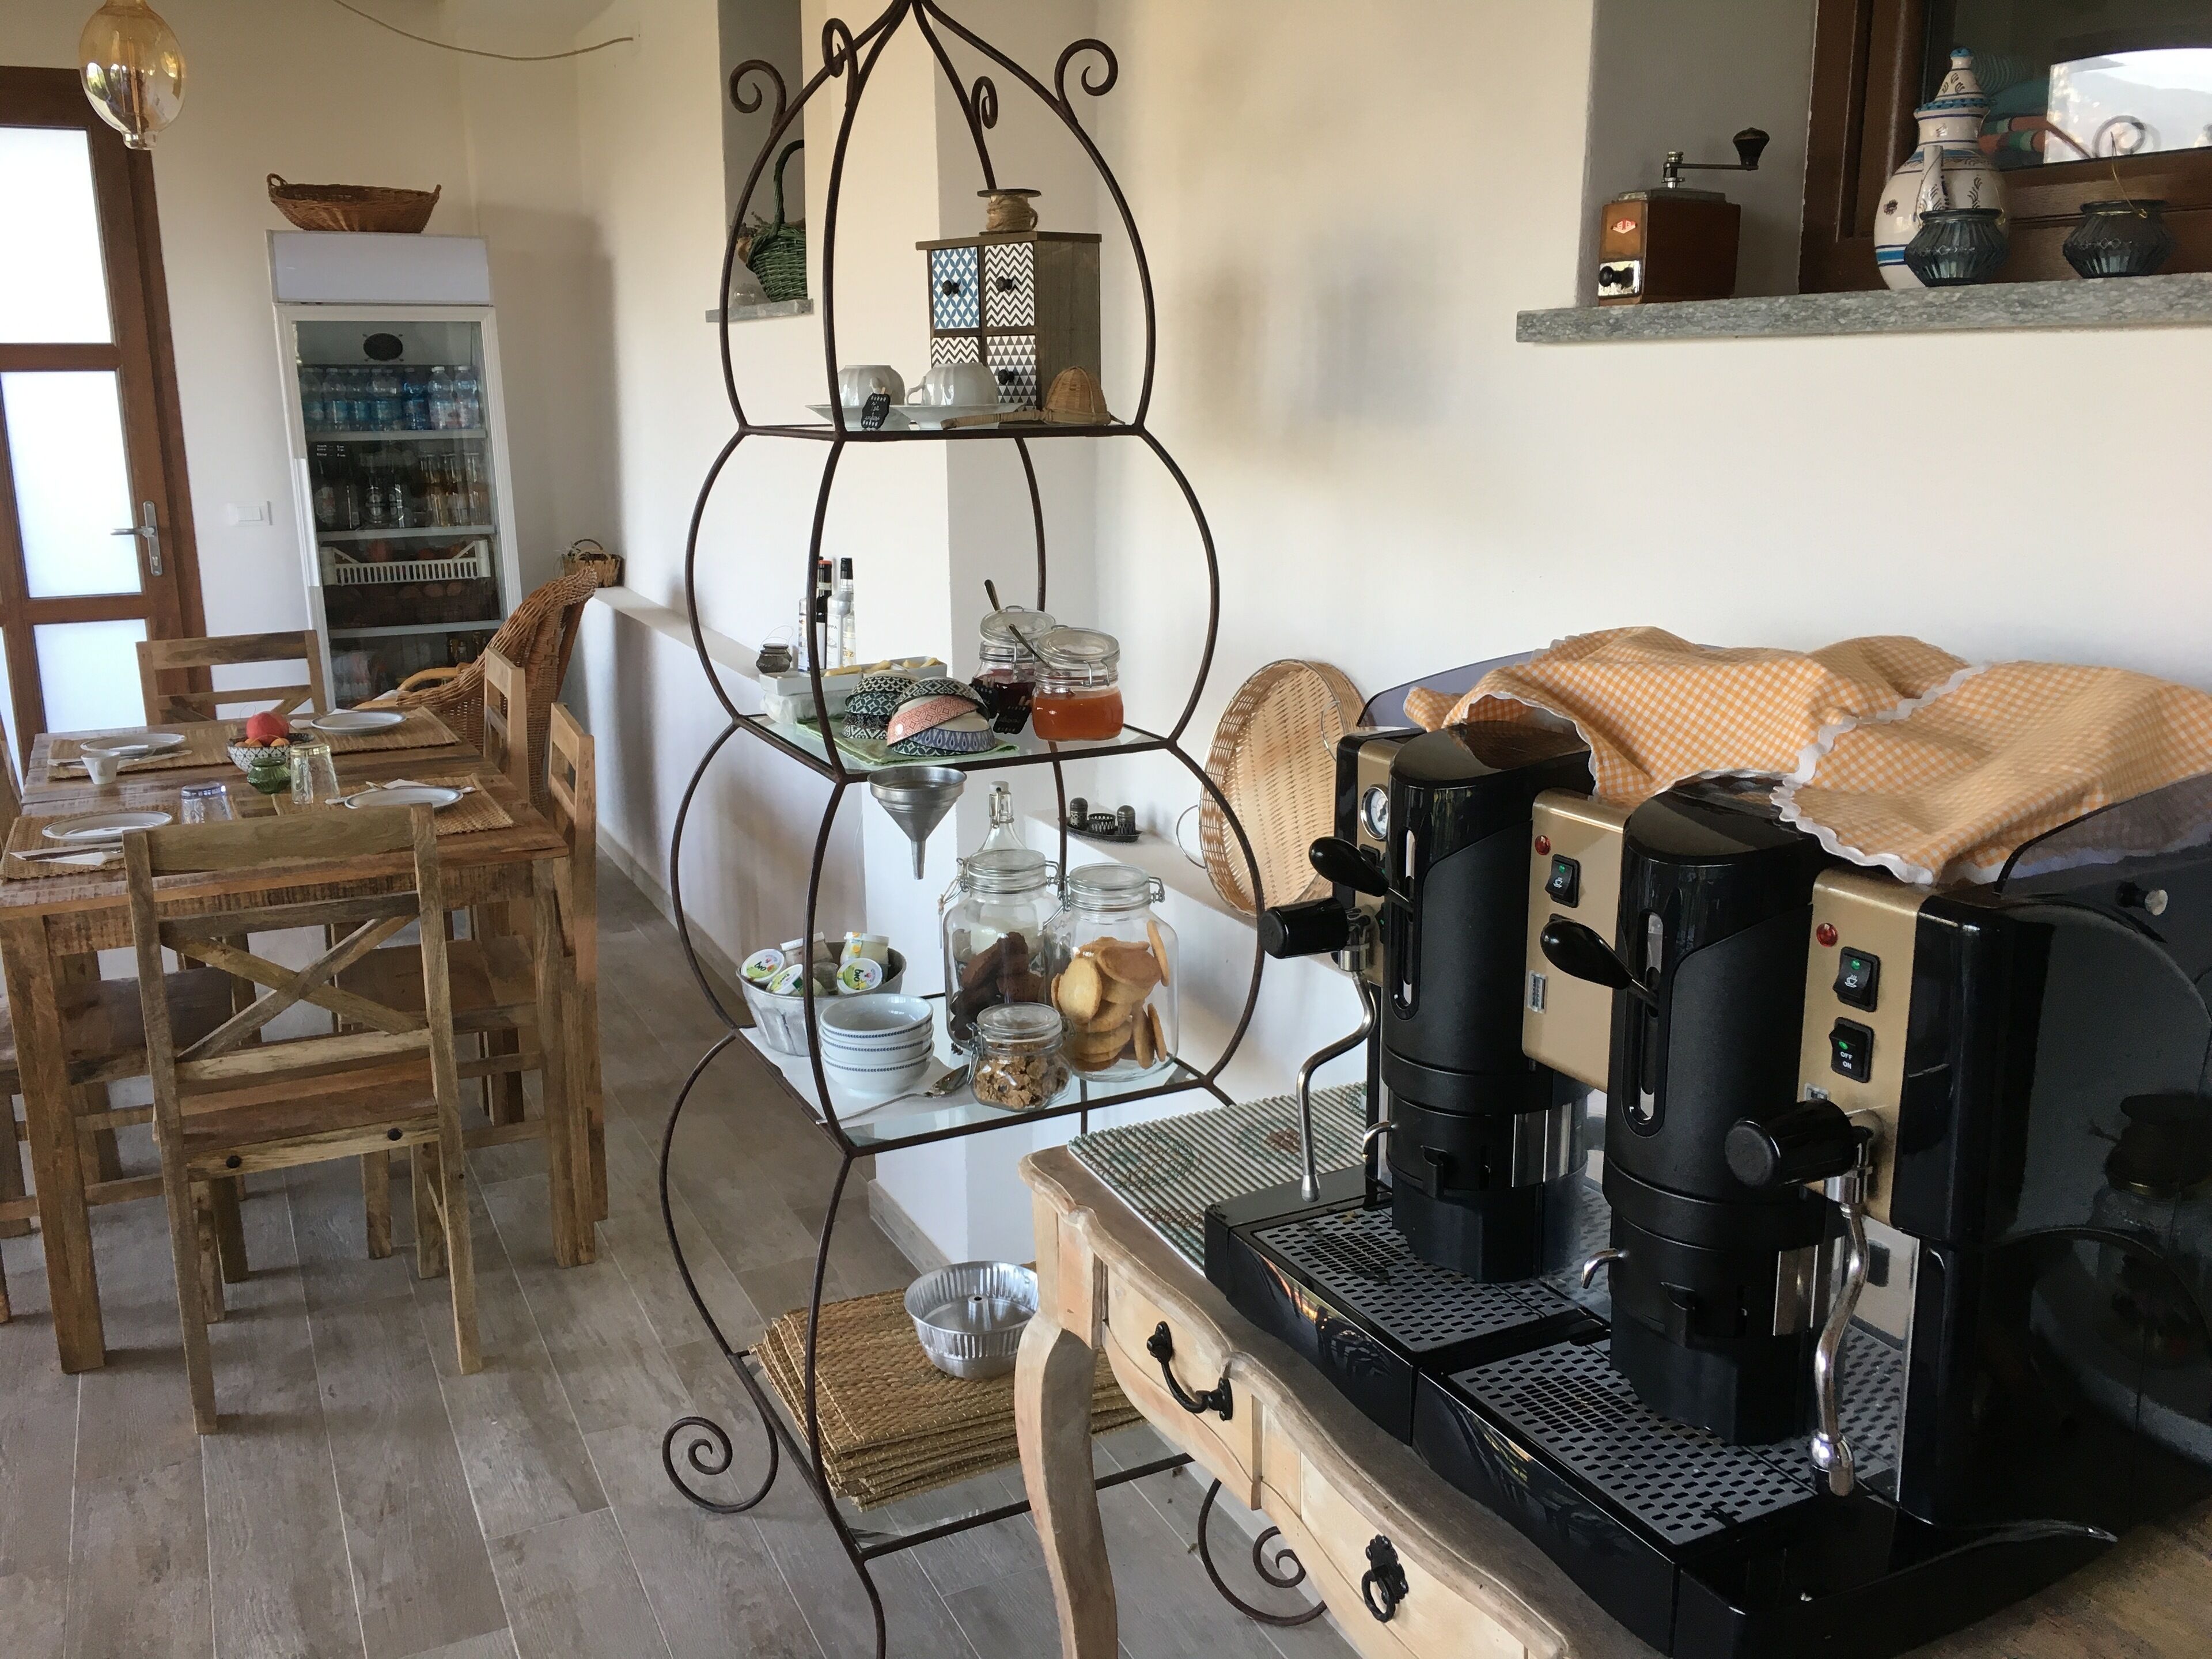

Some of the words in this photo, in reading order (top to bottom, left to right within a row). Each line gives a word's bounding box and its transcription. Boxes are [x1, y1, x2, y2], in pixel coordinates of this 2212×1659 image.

[853, 969, 865, 982] bio
[1840, 1051, 1853, 1060] OFF
[1842, 1060, 1852, 1070] ON
